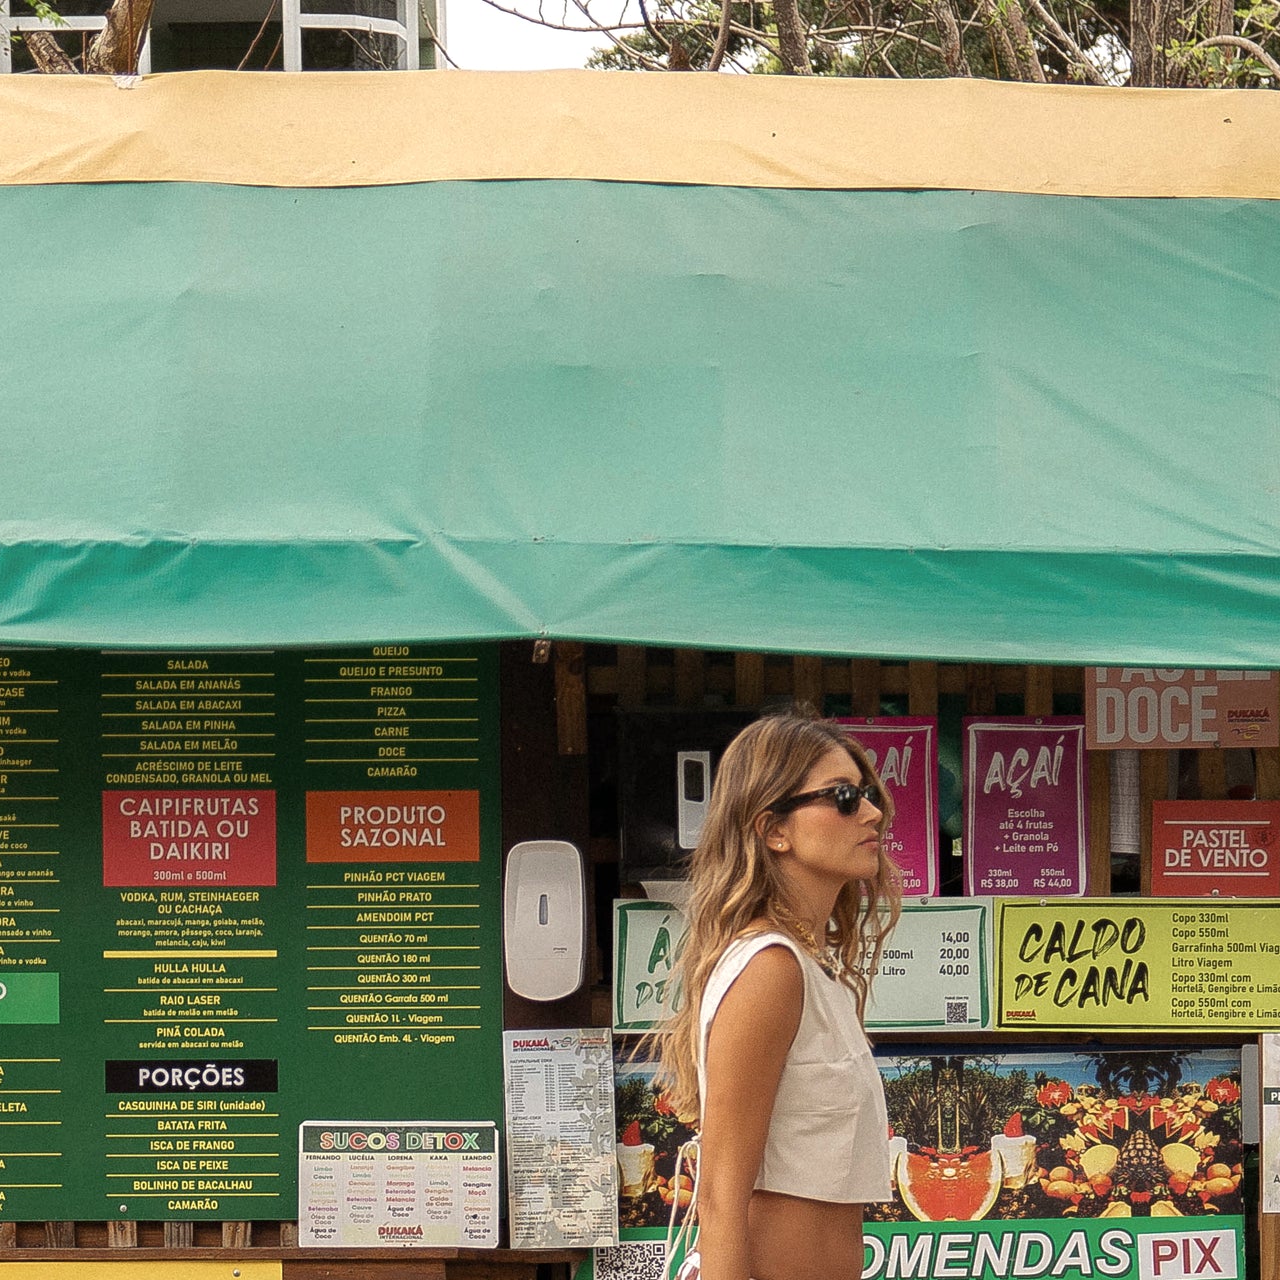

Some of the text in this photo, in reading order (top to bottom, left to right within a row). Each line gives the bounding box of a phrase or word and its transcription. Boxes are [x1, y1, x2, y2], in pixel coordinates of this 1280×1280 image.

[371, 687, 412, 696] FRANGO
[378, 707, 406, 716] PIZZA
[1096, 687, 1218, 743] DOCE
[379, 747, 405, 756] DOCE
[984, 735, 1064, 798] AÇAÍ
[120, 798, 258, 815] CAIPIFRUTAS
[341, 806, 445, 824] PRODUTO
[131, 820, 248, 837] BATIDA OU
[999, 820, 1053, 829] até 4 frutas
[341, 828, 445, 846] SAZONAL
[1183, 829, 1249, 848] PASTEL
[151, 843, 229, 859] DAIKIRI
[1166, 849, 1267, 867] DE VENTO
[981, 879, 1018, 888] R$ 38,00
[1034, 878, 1071, 888] R$ 44,00
[357, 912, 434, 922] AMENDOIM PCT
[1173, 913, 1228, 925] Copo 330ml
[942, 932, 969, 943] 14,00
[1019, 918, 1146, 965] CALDO
[1172, 943, 1223, 952] Garrafinha
[1227, 943, 1256, 952] 500ml
[940, 949, 969, 959] 20,00
[939, 965, 969, 976] 40,00
[358, 973, 400, 983] QUENTÃO
[1015, 958, 1149, 1009] DE CANA
[161, 996, 220, 1005] RAIO LASER
[139, 1064, 244, 1090] PORÇÕES
[158, 1121, 227, 1130] BATATA FRITA
[320, 1132, 480, 1150] SUCOS DETOX
[168, 1198, 218, 1209] CAMARÃO
[1152, 1237, 1222, 1275] PIX
